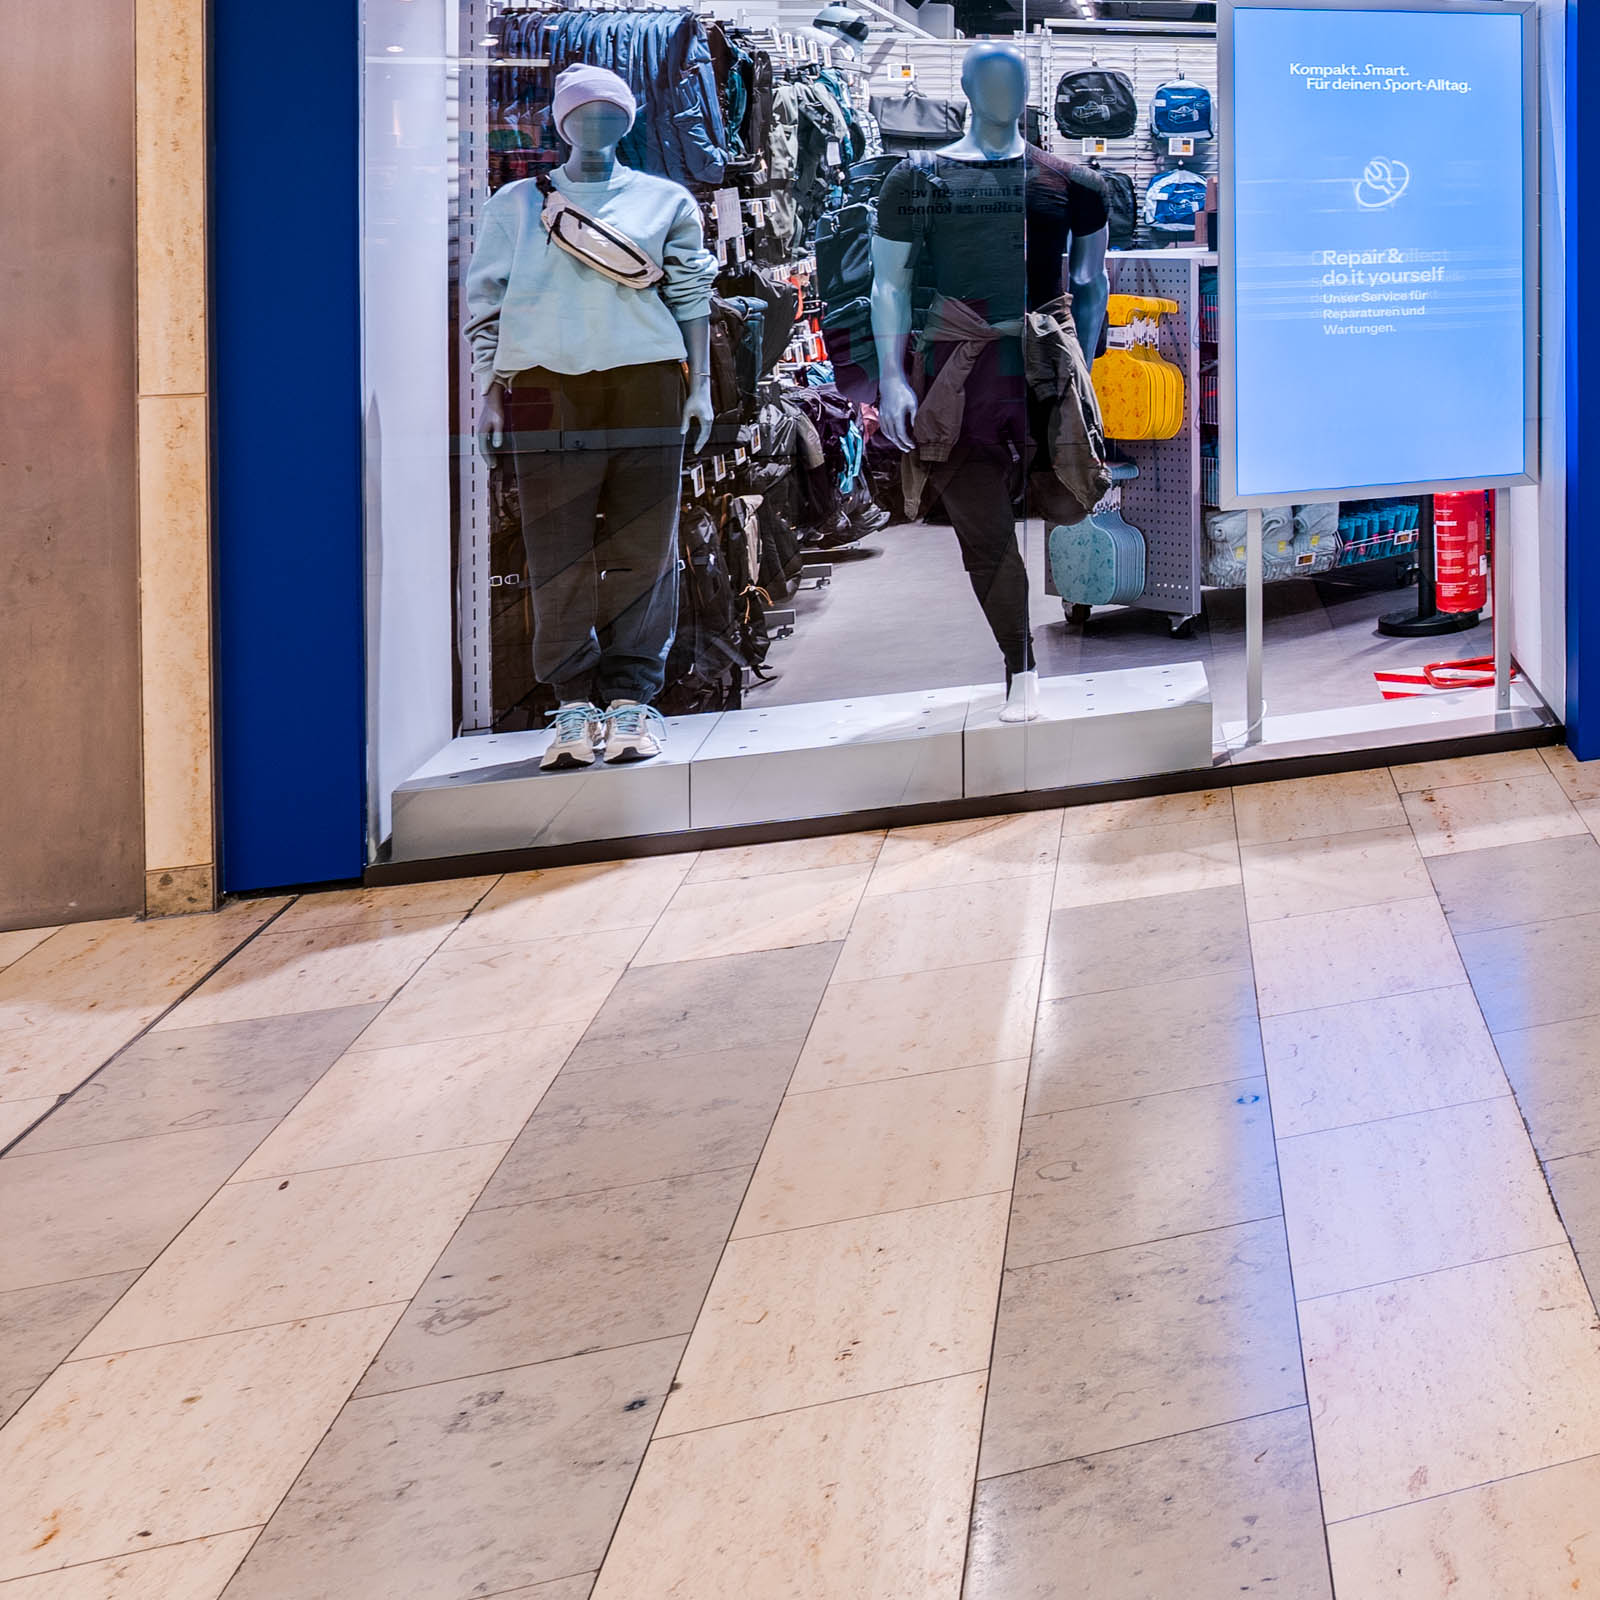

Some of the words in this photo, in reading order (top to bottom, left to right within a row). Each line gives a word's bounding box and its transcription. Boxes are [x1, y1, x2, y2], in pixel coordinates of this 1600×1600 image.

[1290, 63, 1361, 77] Kompakt.
[1363, 64, 1409, 76] Smart.
[1306, 78, 1331, 90] Für
[1333, 78, 1381, 90] deinen
[1383, 79, 1472, 93] Sport-Alltag.
[1323, 249, 1385, 268] Repair
[1388, 248, 1402, 263] &
[1322, 269, 1347, 285] do
[1351, 268, 1364, 284] it
[1368, 266, 1445, 287] yourself
[1323, 293, 1360, 304] Unser
[1361, 291, 1407, 302] Service
[1409, 289, 1428, 300] für
[1323, 306, 1400, 321] Reparaturen
[1401, 305, 1425, 316] und
[1323, 323, 1396, 336] Wartungen.
